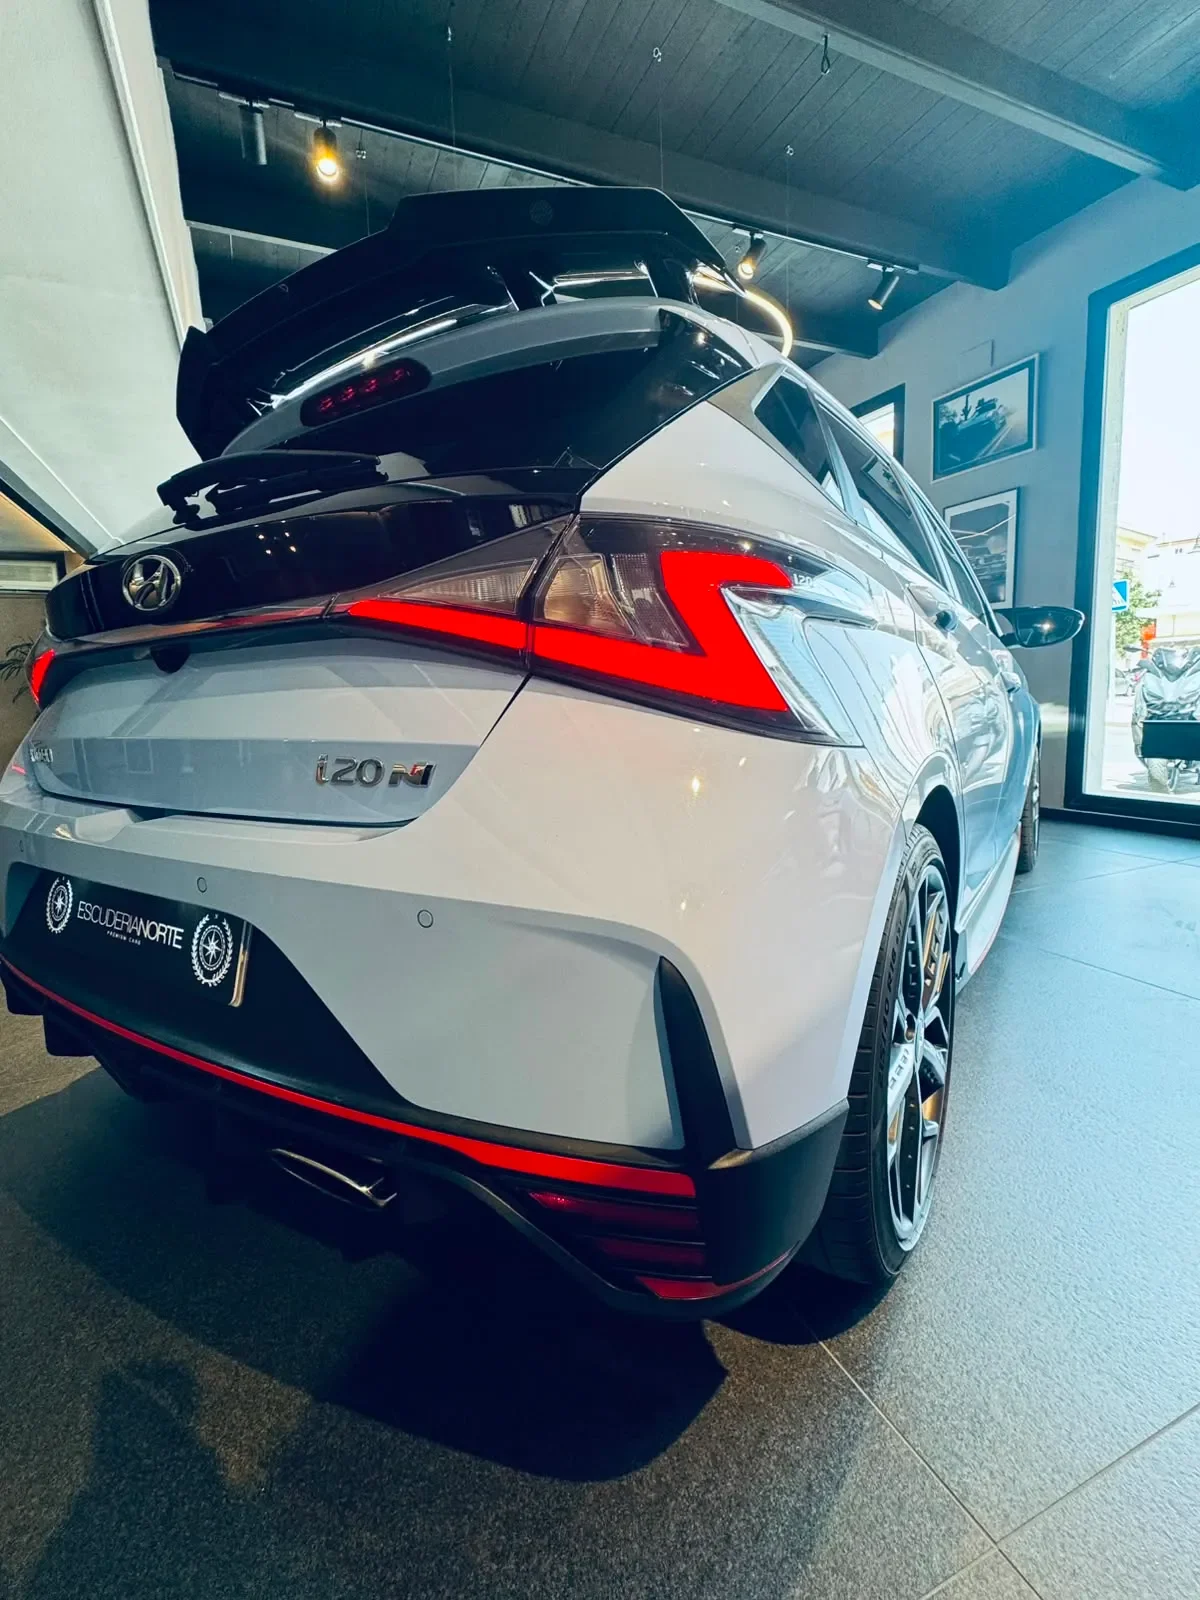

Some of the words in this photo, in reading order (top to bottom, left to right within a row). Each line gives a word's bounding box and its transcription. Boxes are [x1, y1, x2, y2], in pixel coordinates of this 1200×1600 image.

[315, 753, 385, 787] i20
[77, 901, 184, 949] ESCUDERIANORTE
[106, 930, 127, 941] PREMIUM
